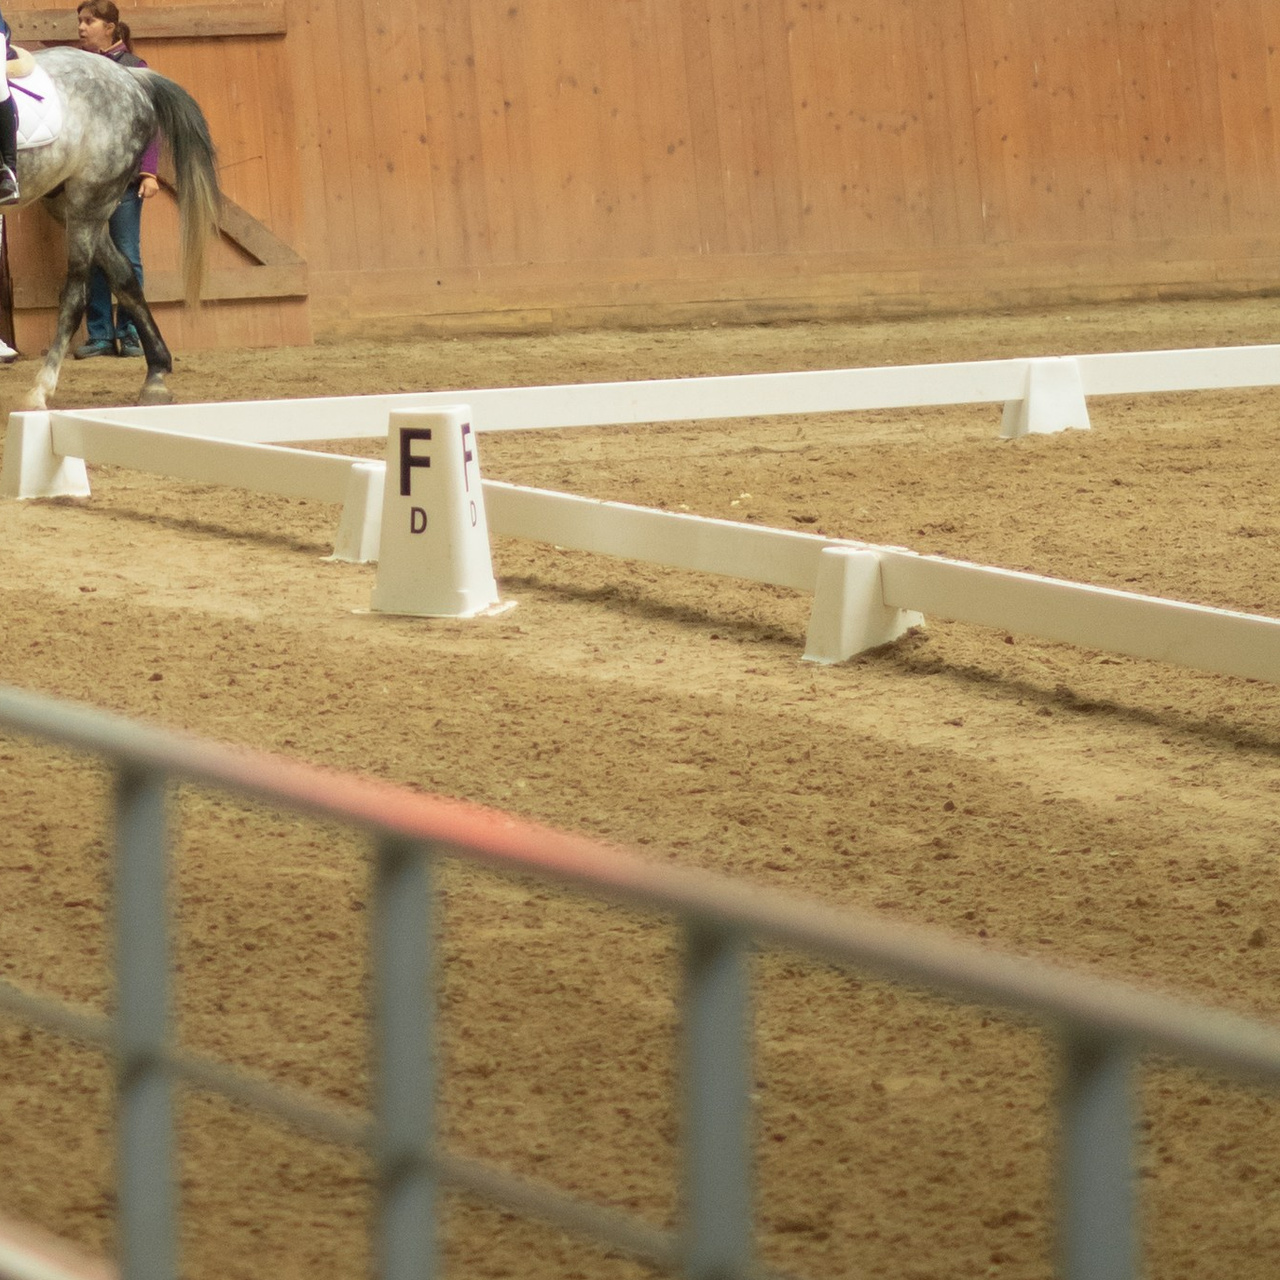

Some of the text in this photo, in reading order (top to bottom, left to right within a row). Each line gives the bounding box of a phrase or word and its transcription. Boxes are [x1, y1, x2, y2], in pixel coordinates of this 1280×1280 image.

[399, 427, 432, 497] F
[461, 422, 473, 492] F
[410, 506, 428, 534] D
